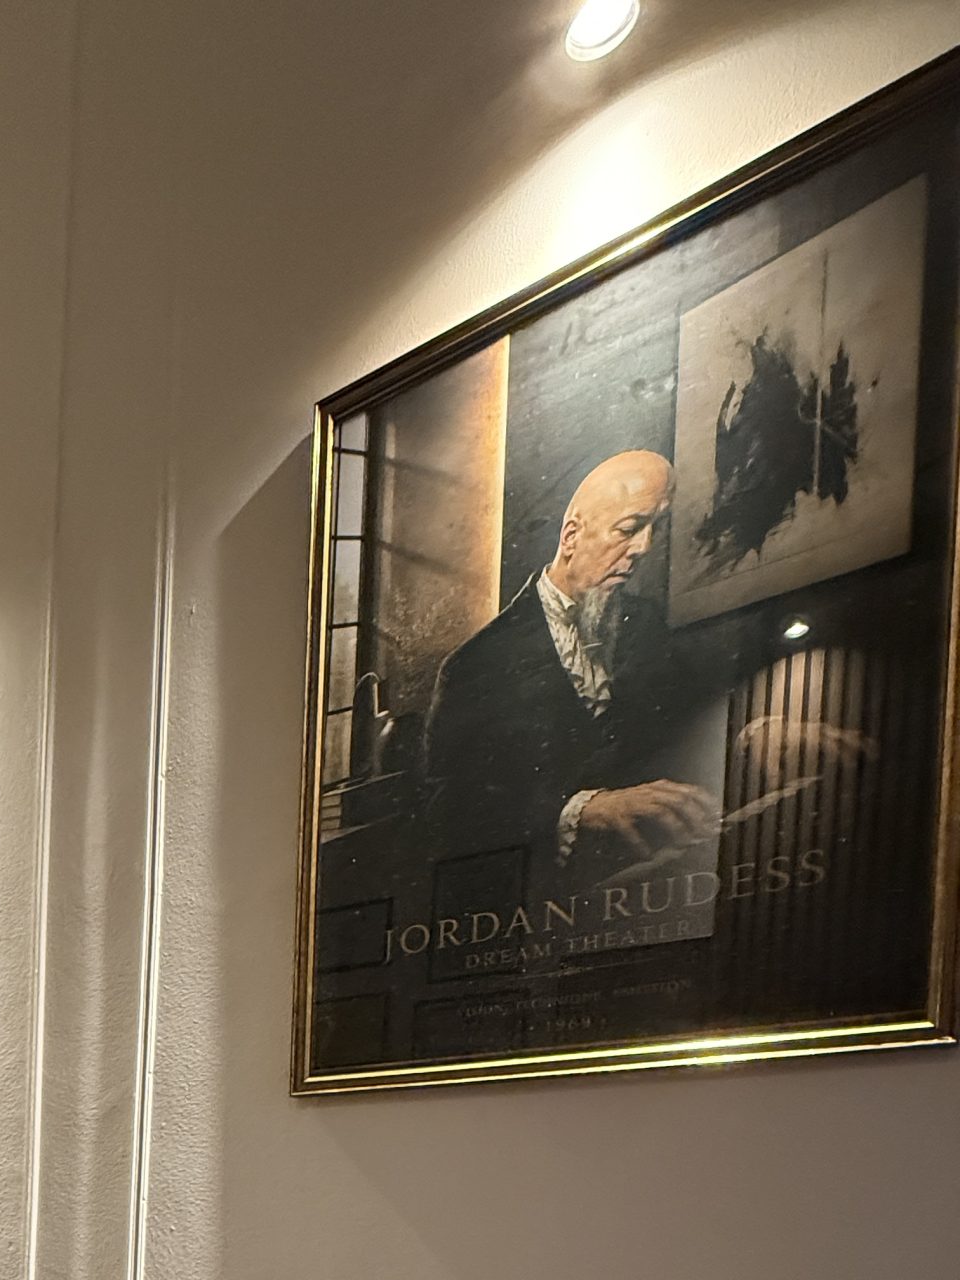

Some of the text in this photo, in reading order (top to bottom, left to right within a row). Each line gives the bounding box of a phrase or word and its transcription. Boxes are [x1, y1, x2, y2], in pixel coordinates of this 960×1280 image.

[384, 848, 827, 964] JORDAN RUDESS
[464, 919, 692, 970] DREAM THEATER
